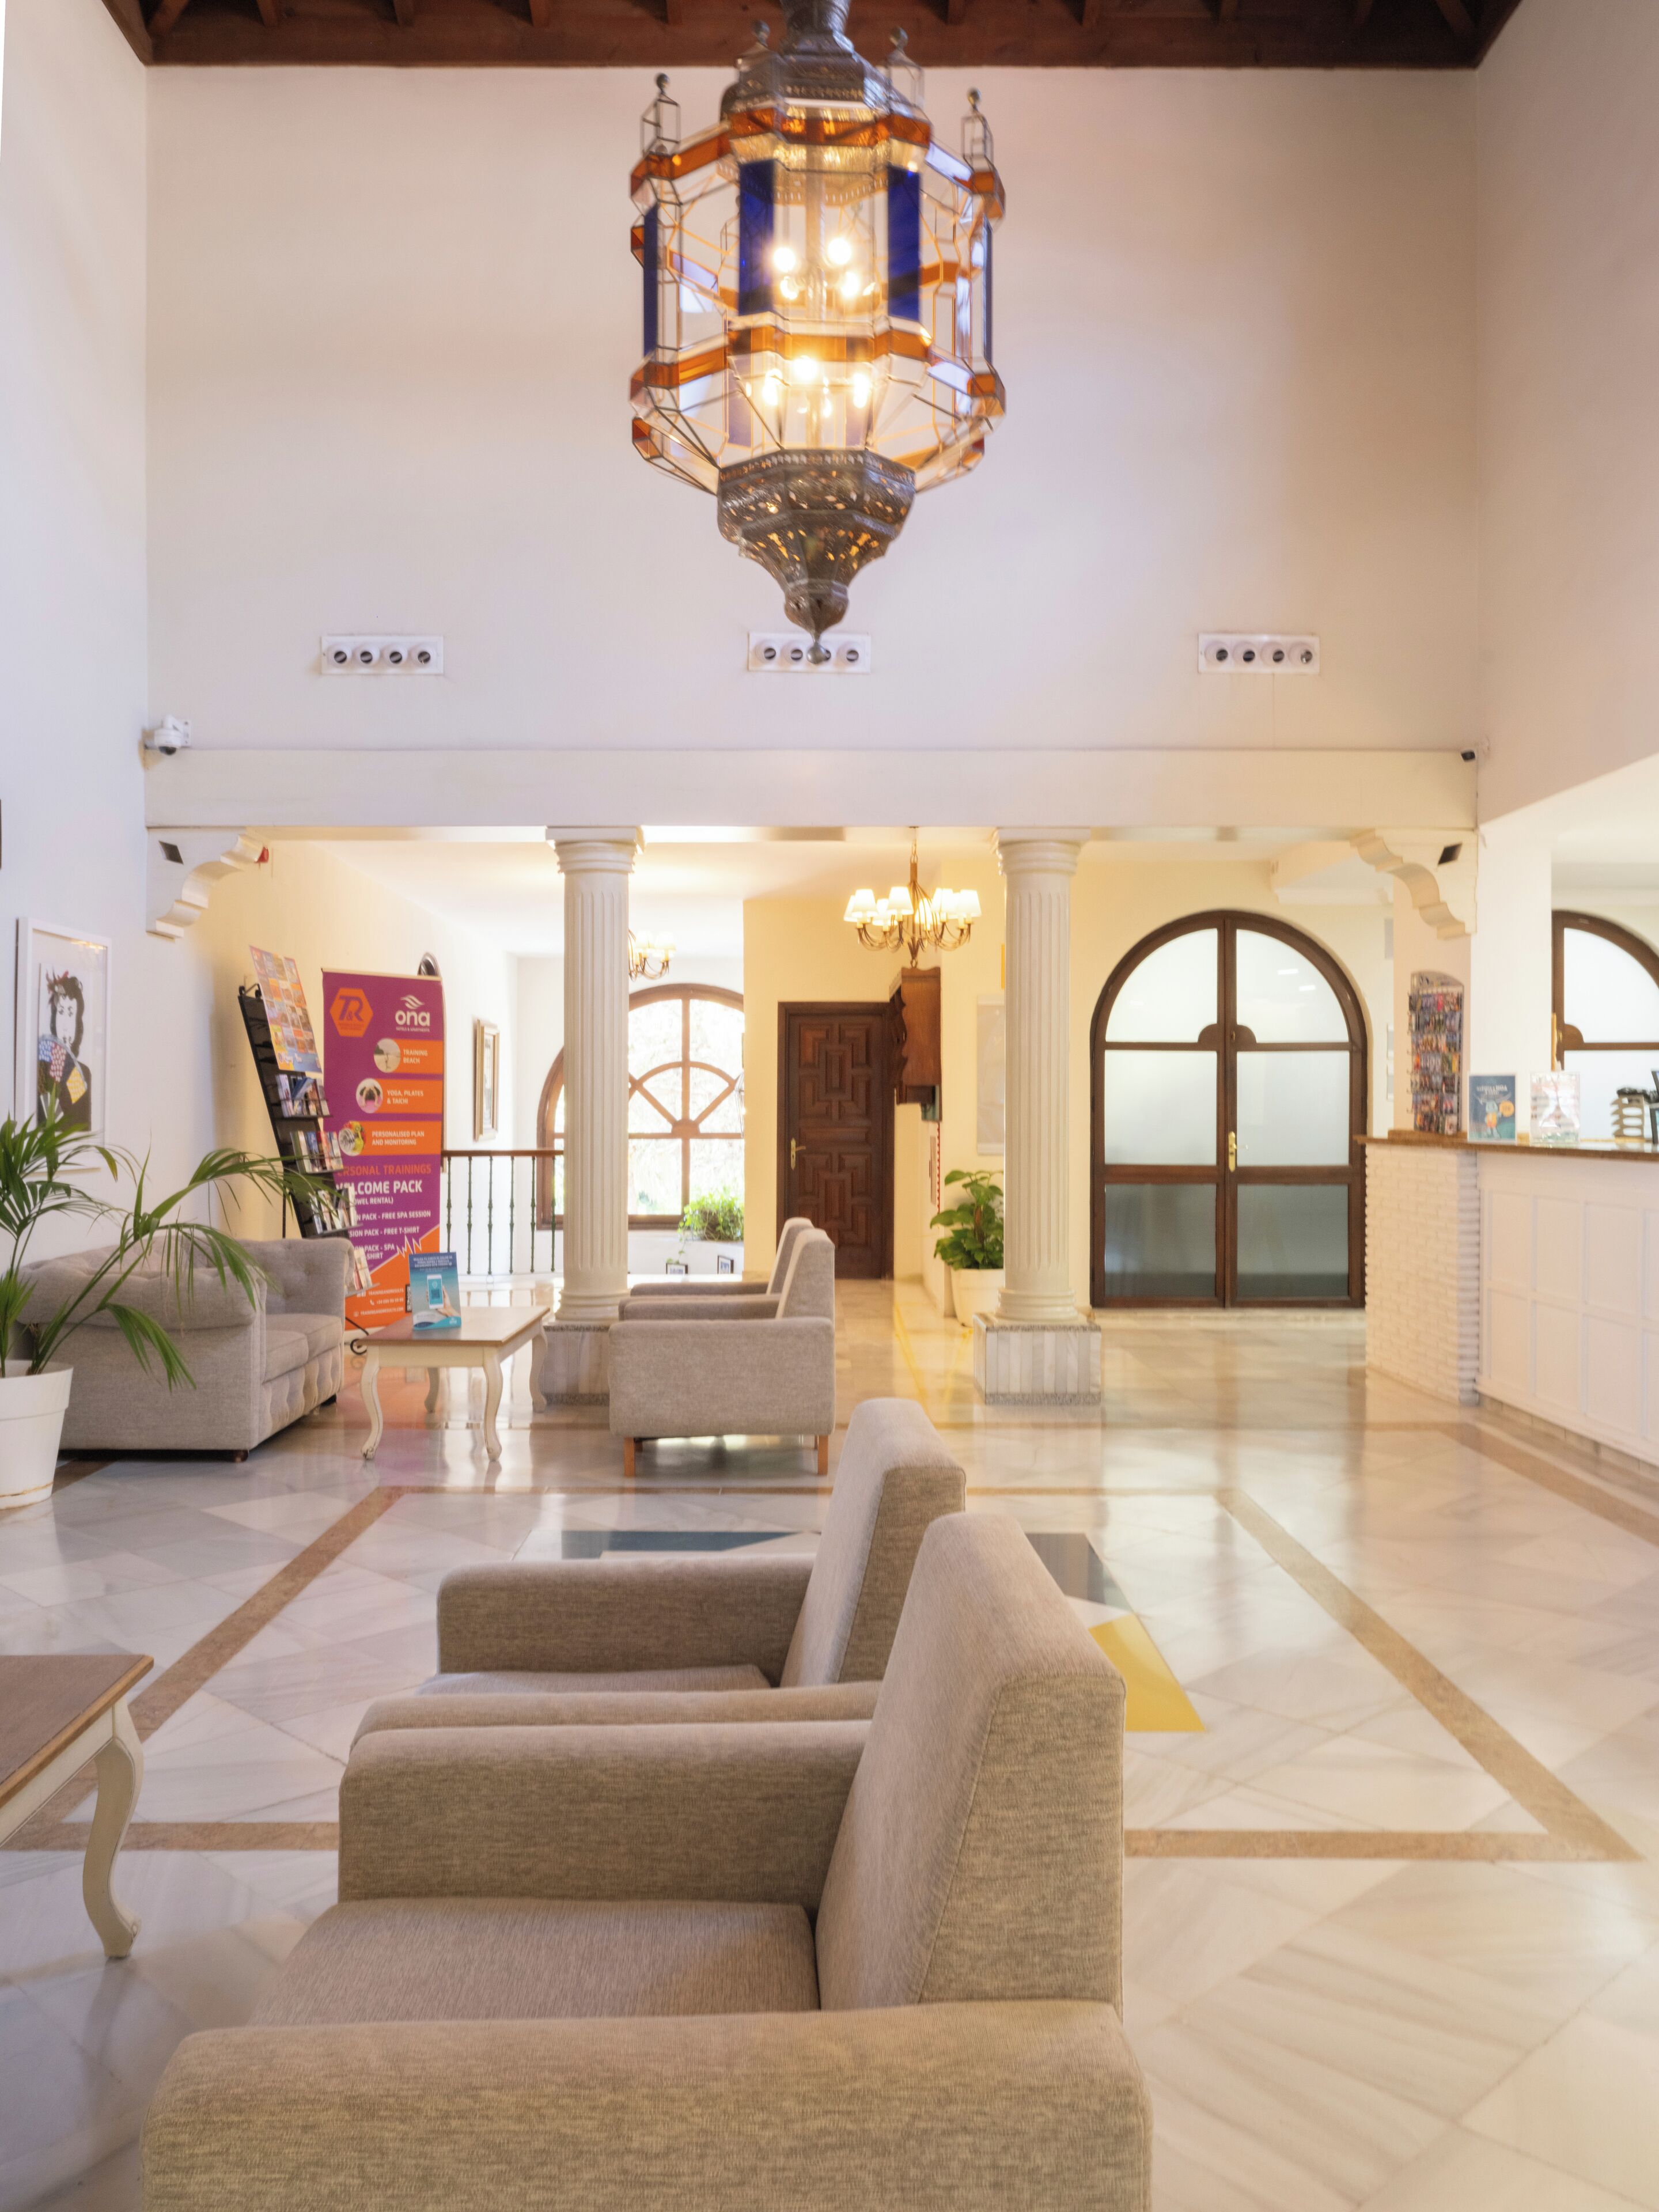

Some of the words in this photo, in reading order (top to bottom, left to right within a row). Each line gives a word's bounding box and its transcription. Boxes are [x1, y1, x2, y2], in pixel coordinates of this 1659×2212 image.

[395, 1010, 430, 1027] ona
[338, 1165, 380, 1177] RSONAL
[383, 1164, 431, 1175] TRAININGS
[393, 1179, 422, 1194] PACK
[370, 1196, 393, 1205] RENTAL)
[362, 1213, 377, 1221] PACK
[364, 1228, 379, 1237] PACK
[399, 1226, 420, 1234] T-SHIRT
